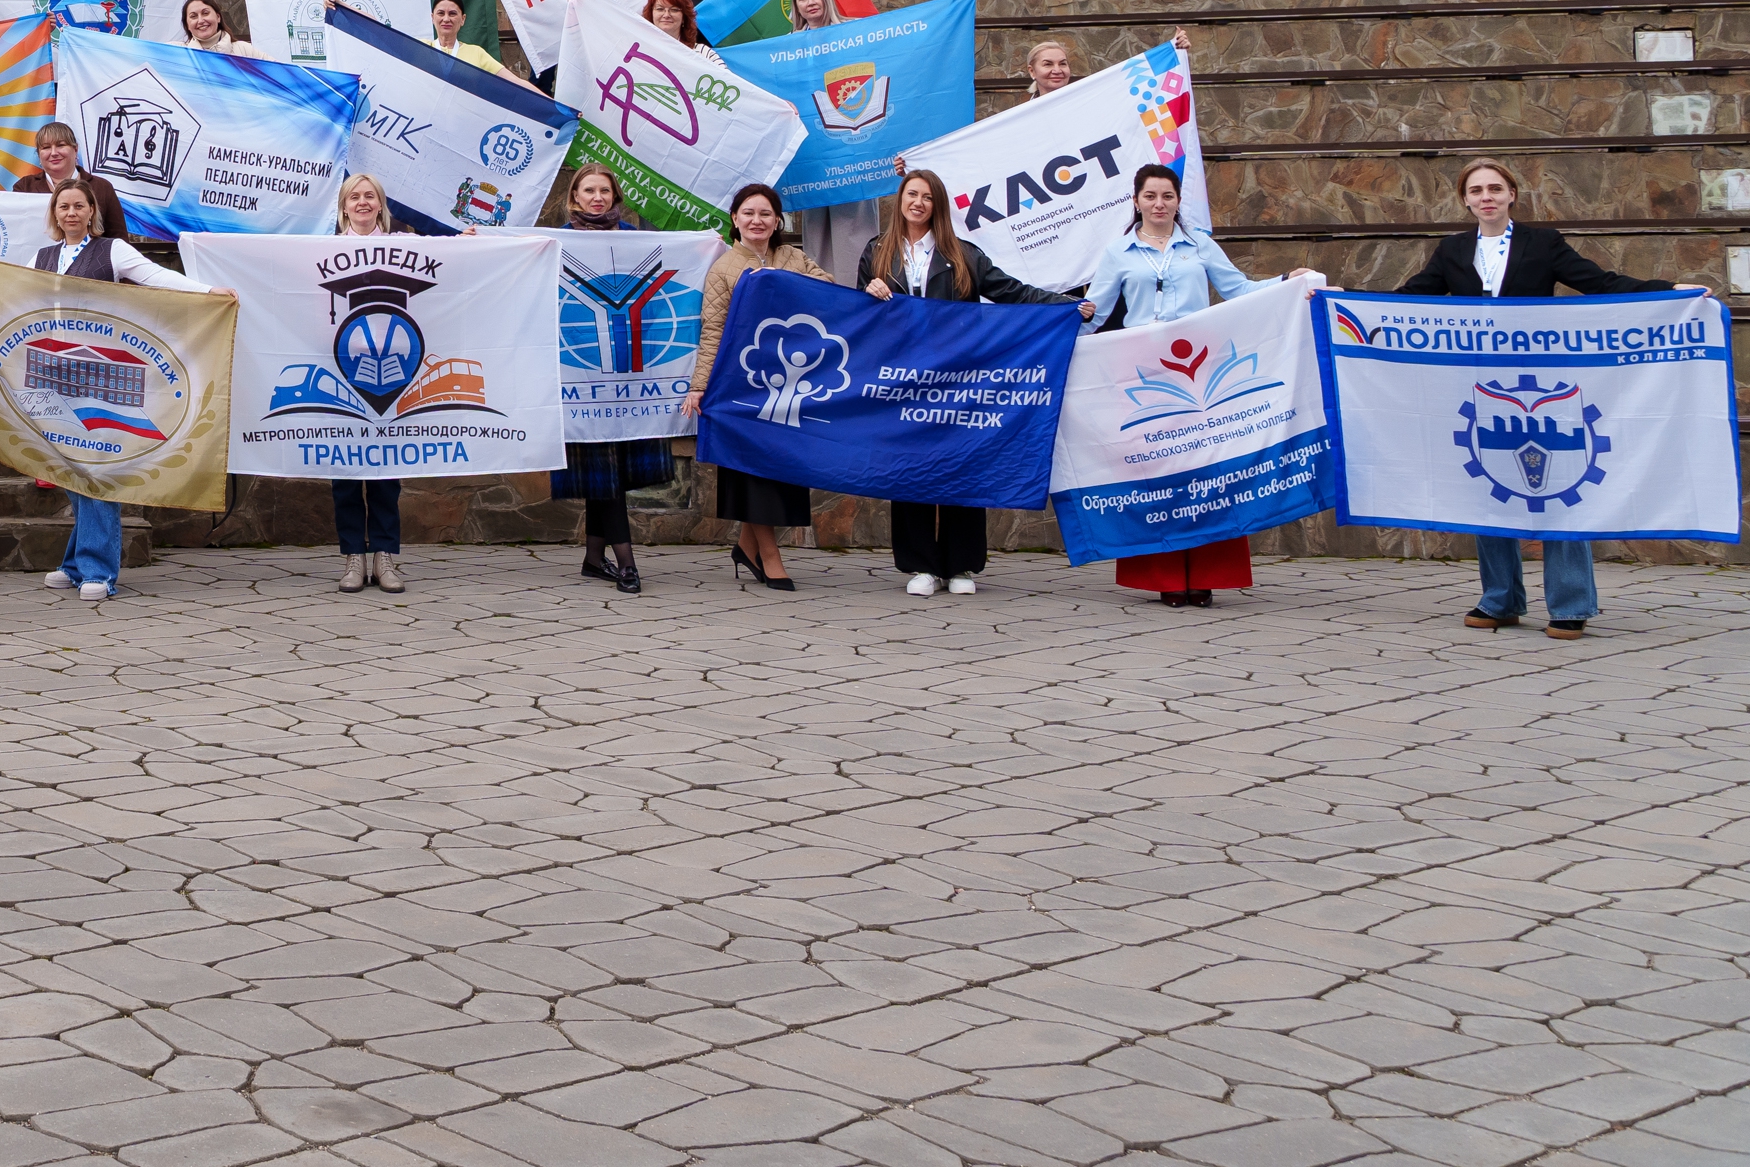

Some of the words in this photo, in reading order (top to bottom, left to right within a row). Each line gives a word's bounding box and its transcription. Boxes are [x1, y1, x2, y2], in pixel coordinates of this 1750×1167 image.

[769, 35, 863, 64] УЛЬЯНОВСКАЯ
[867, 19, 928, 44] ОБЛАСТЬ
[493, 134, 523, 161] 85
[208, 146, 333, 178] КАМЕНСК-УРАЛЬСКИЙ
[489, 162, 507, 175] СПО
[205, 168, 309, 197] ПЕДАГОГИЧЕСКИЙ
[954, 134, 1122, 232] КАСТ
[201, 189, 258, 212] КОЛЛЕДЖ
[1010, 202, 1075, 232] Краснодарский
[1016, 193, 1132, 243] архитектурно-строительный
[0, 237, 9, 258] ПРАВА
[1020, 234, 1059, 253] техникум
[316, 247, 444, 279] КОЛЛЕДЖ
[1381, 315, 1495, 327] РЫБИНСКИЙ
[1381, 317, 1706, 352] ПОЛИГРАФИЧЕСКИЙ
[0, 319, 113, 357] ПЕДАГОГИЧЕСКИЙ
[120, 331, 179, 385] КОЛЛЕДЖ
[1617, 348, 1707, 364] КОЛЛЕДЖ
[877, 365, 1047, 384] ВЛАДИМИРСКИЙ
[561, 380, 691, 400] МГИМО
[861, 383, 1052, 407] ПЕДАГОГИЧЕСКИЙ
[570, 404, 682, 419] УНИВЕРСИТЕТ
[900, 407, 1003, 429] КОЛЛЕДЖ
[1144, 400, 1271, 444] Кабардино-Балкарский
[41, 430, 122, 454] ЧЕРЕПАНОВО
[243, 426, 354, 443] МЕТРОПОЛИТЕНА
[361, 427, 369, 437] И
[376, 425, 526, 441] ЖЕЛЕЗНОДОРОЖНОГО
[1124, 425, 1255, 465] СЕЛЬСКОХОЗЯЙСТВЕННЫЙ
[1256, 407, 1297, 431] КОЛЛЕДЖ
[298, 441, 469, 466] ТРАНСПОРТА
[1082, 486, 1174, 514] Образование
[1188, 459, 1275, 500] фундамент
[1278, 443, 1323, 470] жизни
[1145, 510, 1168, 524] его
[1171, 495, 1231, 522] строим
[1234, 485, 1255, 503] на
[1257, 463, 1317, 497] совесть!
